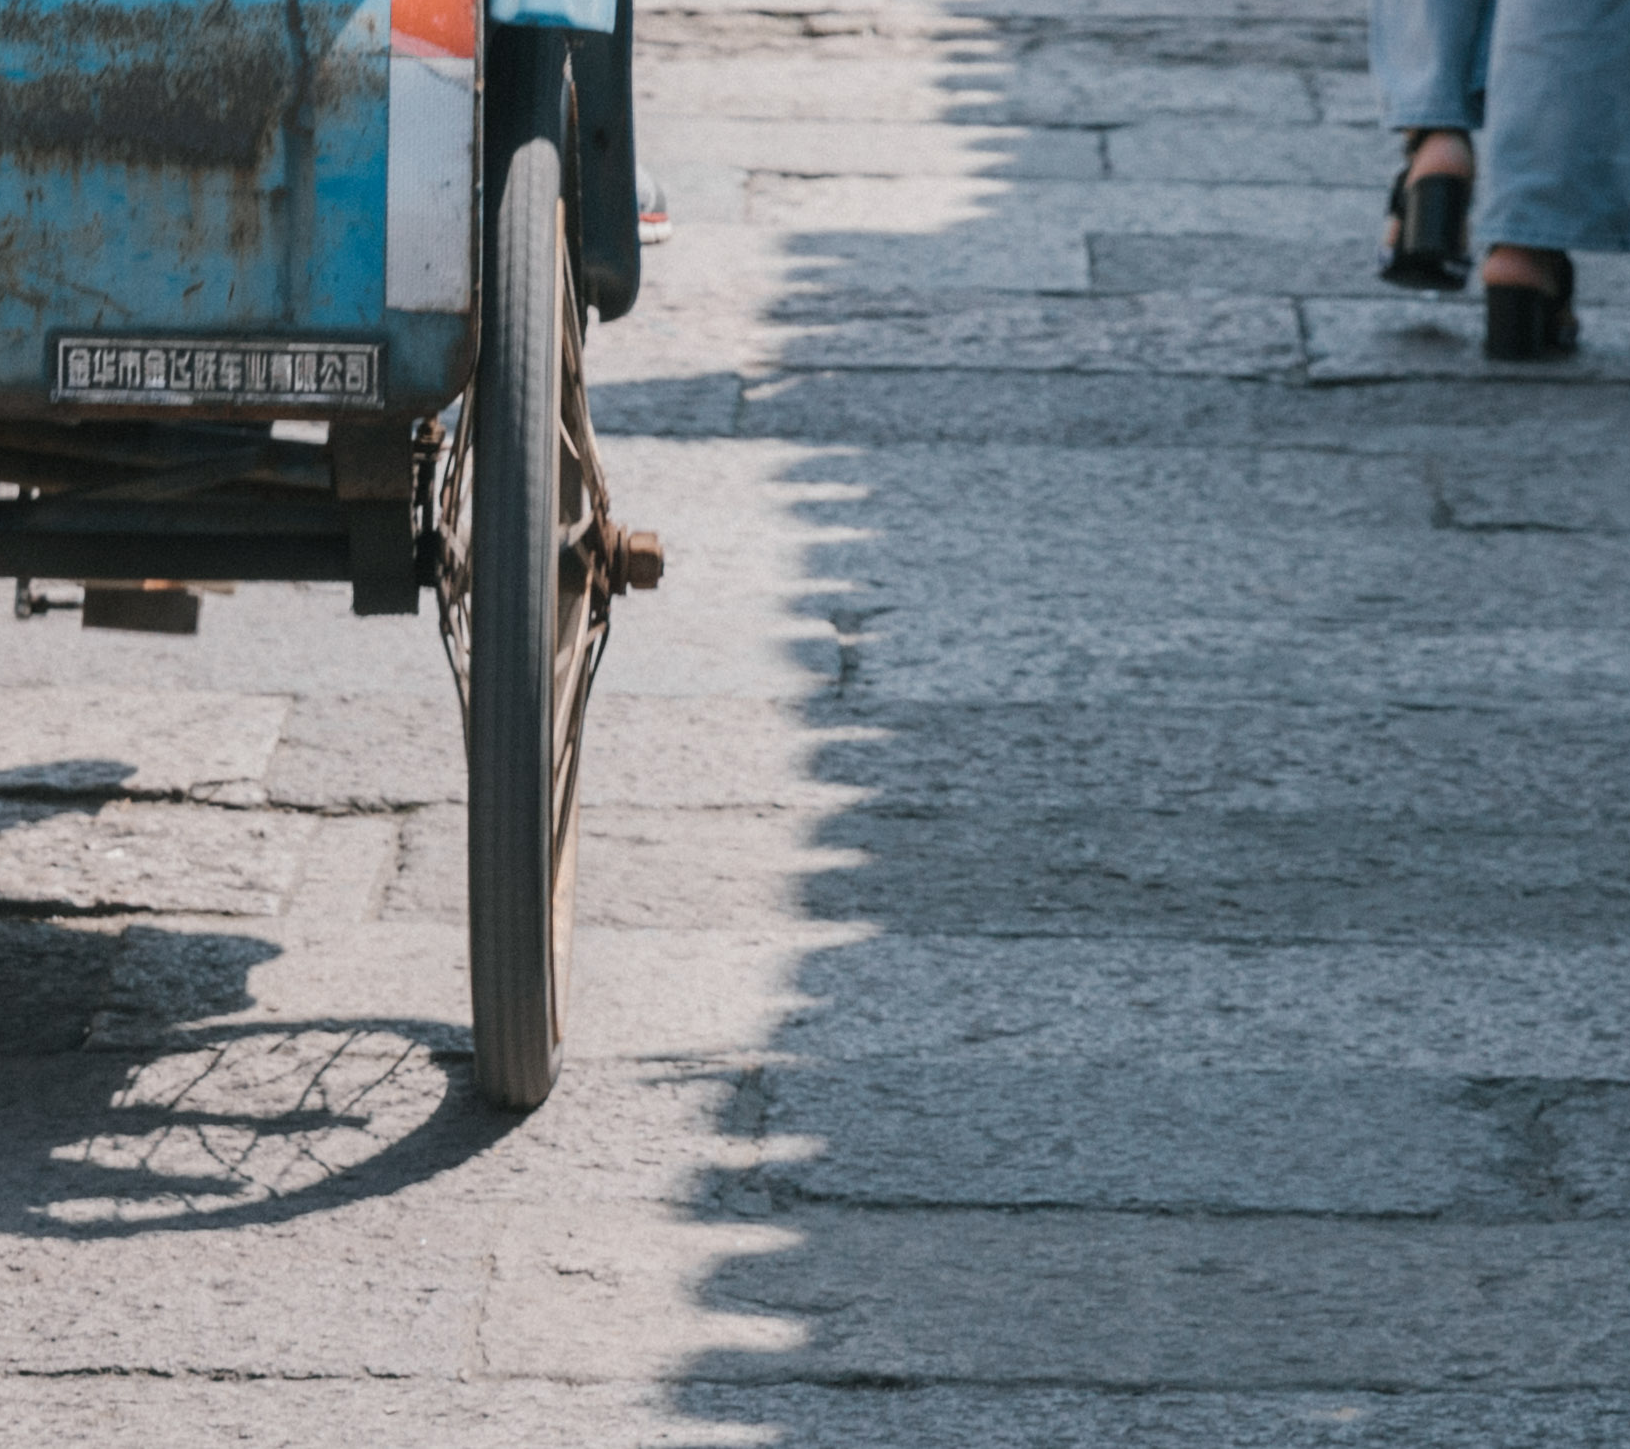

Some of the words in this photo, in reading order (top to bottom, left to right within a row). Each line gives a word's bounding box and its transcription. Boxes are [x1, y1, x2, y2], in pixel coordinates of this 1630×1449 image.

[67, 348, 369, 394] 金华市金飞跃车业有限公司
